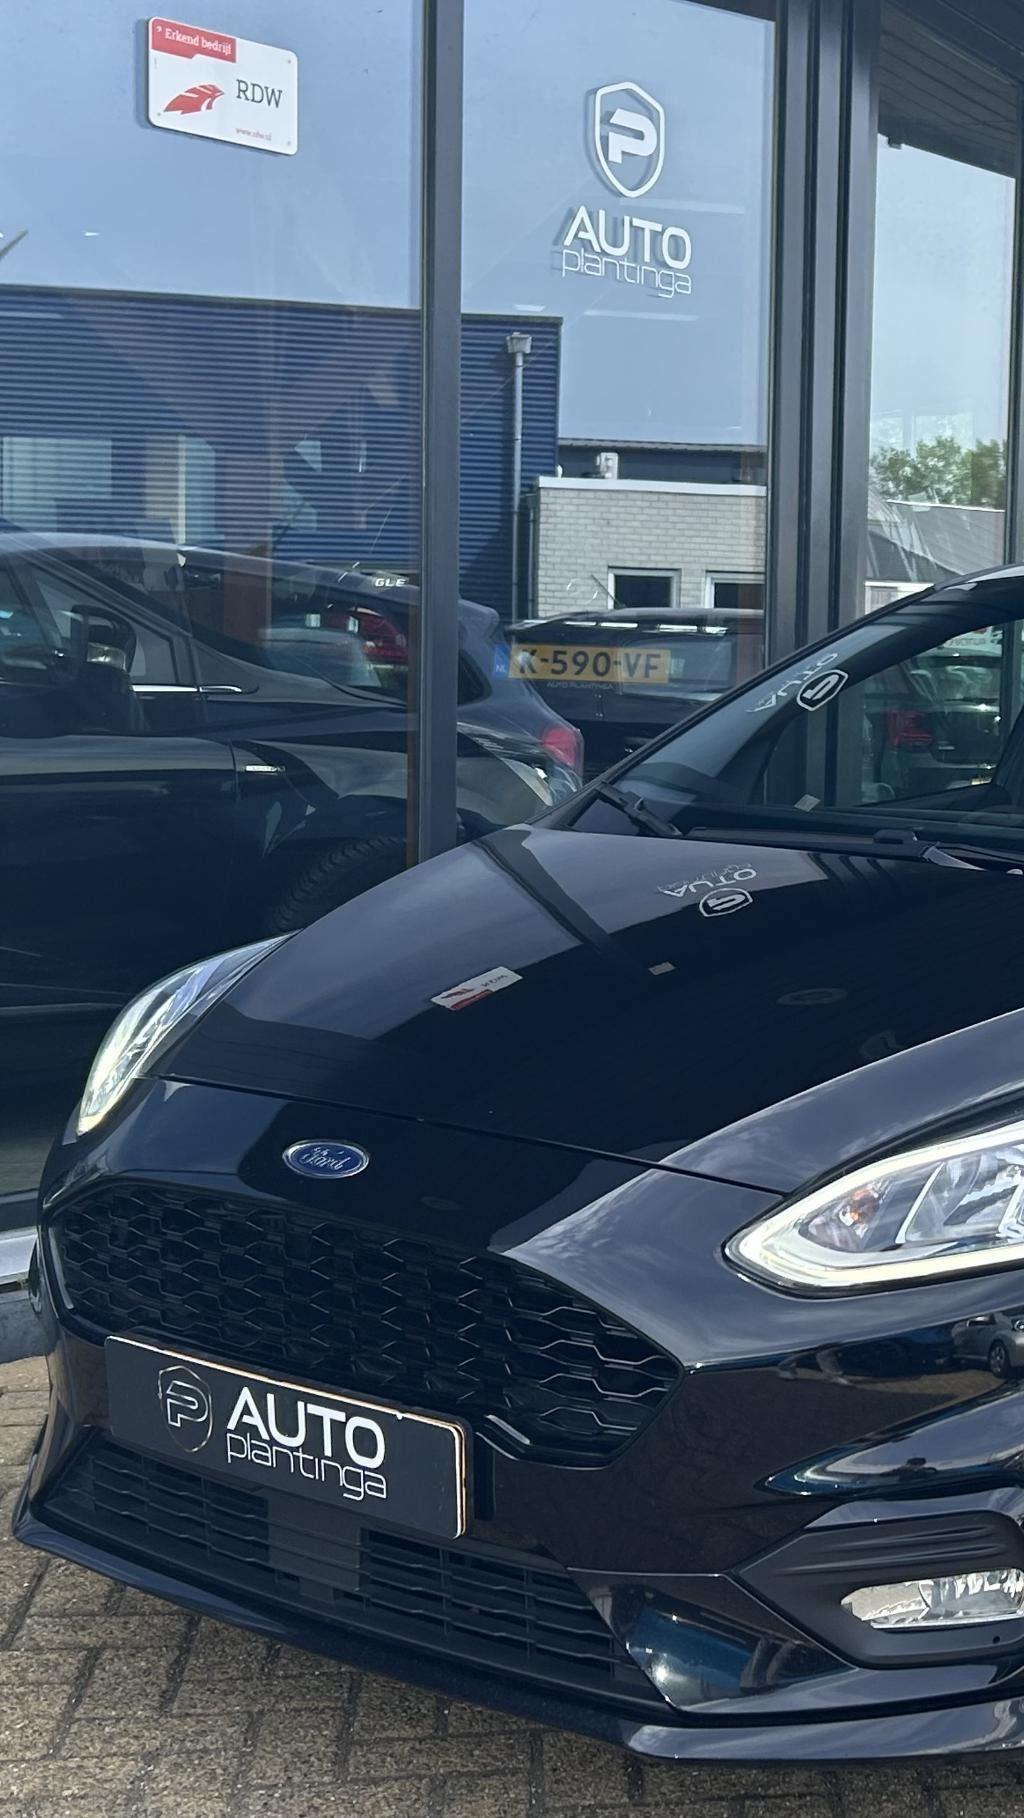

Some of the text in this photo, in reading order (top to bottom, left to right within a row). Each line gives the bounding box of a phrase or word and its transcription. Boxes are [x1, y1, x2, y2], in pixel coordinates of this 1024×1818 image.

[165, 27, 199, 47] Erkend
[235, 78, 283, 109] RDW
[563, 205, 692, 270] AUTO
[562, 247, 692, 299] plantinga
[375, 578, 406, 588] GLE
[519, 648, 662, 680] K-590-VF
[300, 1146, 352, 1171] Ford
[226, 1386, 386, 1470] AUTO
[226, 1431, 387, 1501] plantinga
